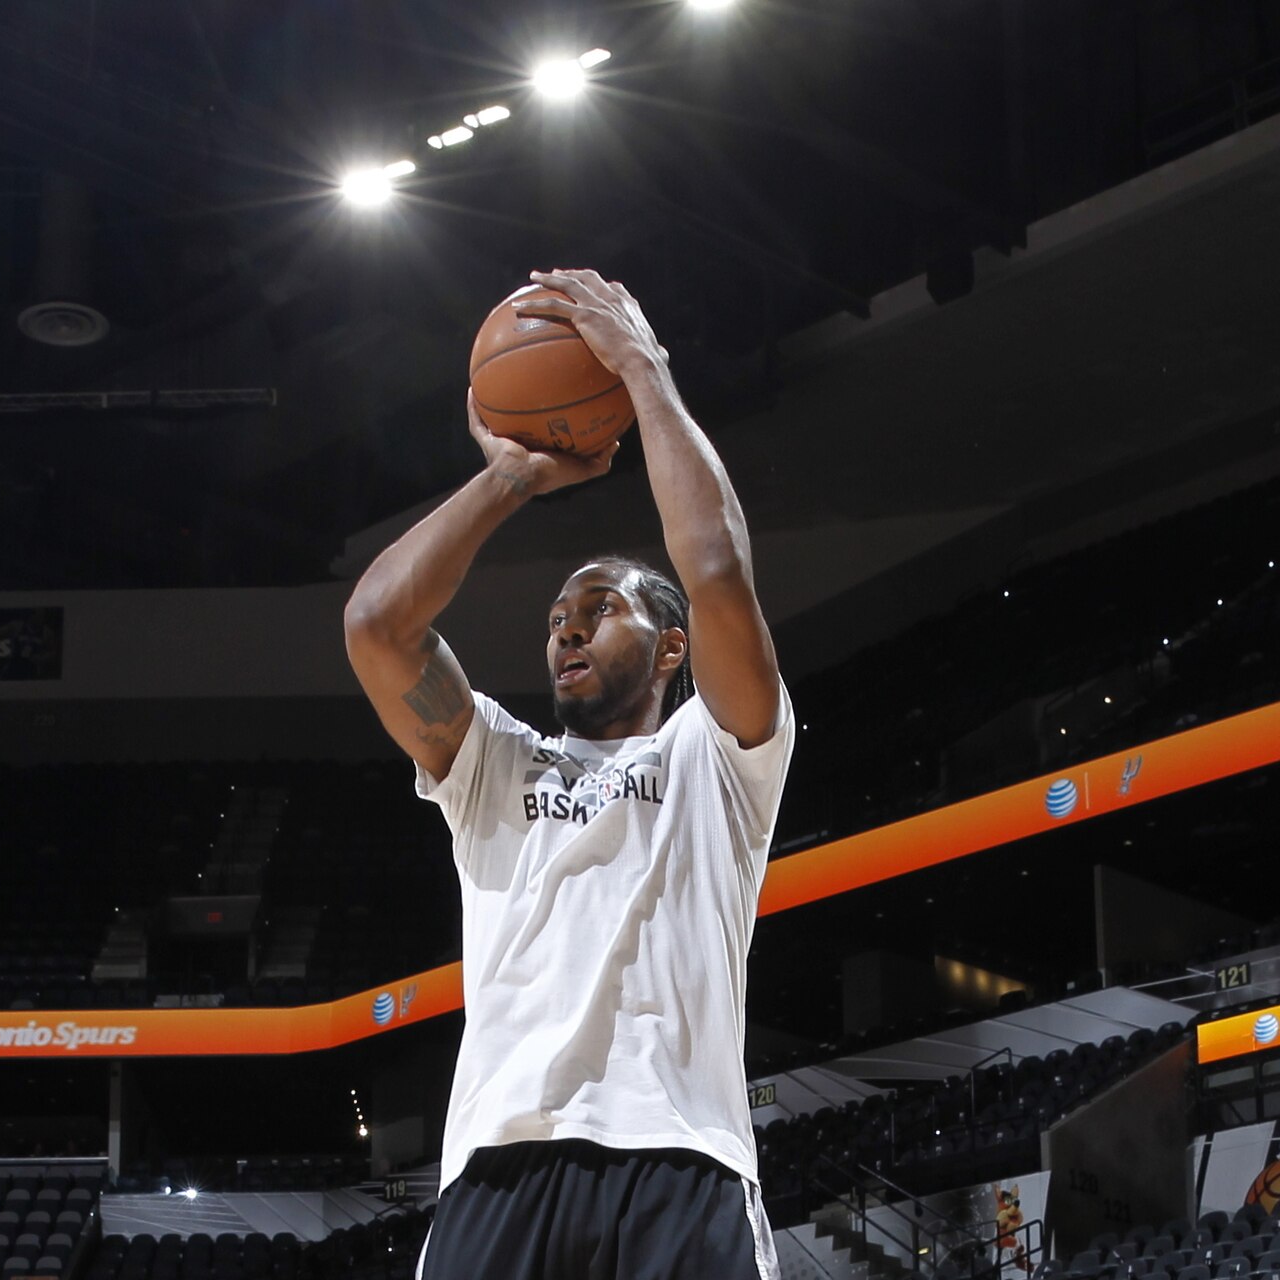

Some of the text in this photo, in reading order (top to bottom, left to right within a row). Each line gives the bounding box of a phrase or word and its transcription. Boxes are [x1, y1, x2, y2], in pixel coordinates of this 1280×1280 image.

[1218, 965, 1248, 988] 121
[53, 1022, 136, 1050] Spurs
[749, 1083, 774, 1107] 120
[385, 1180, 406, 1199] 119
